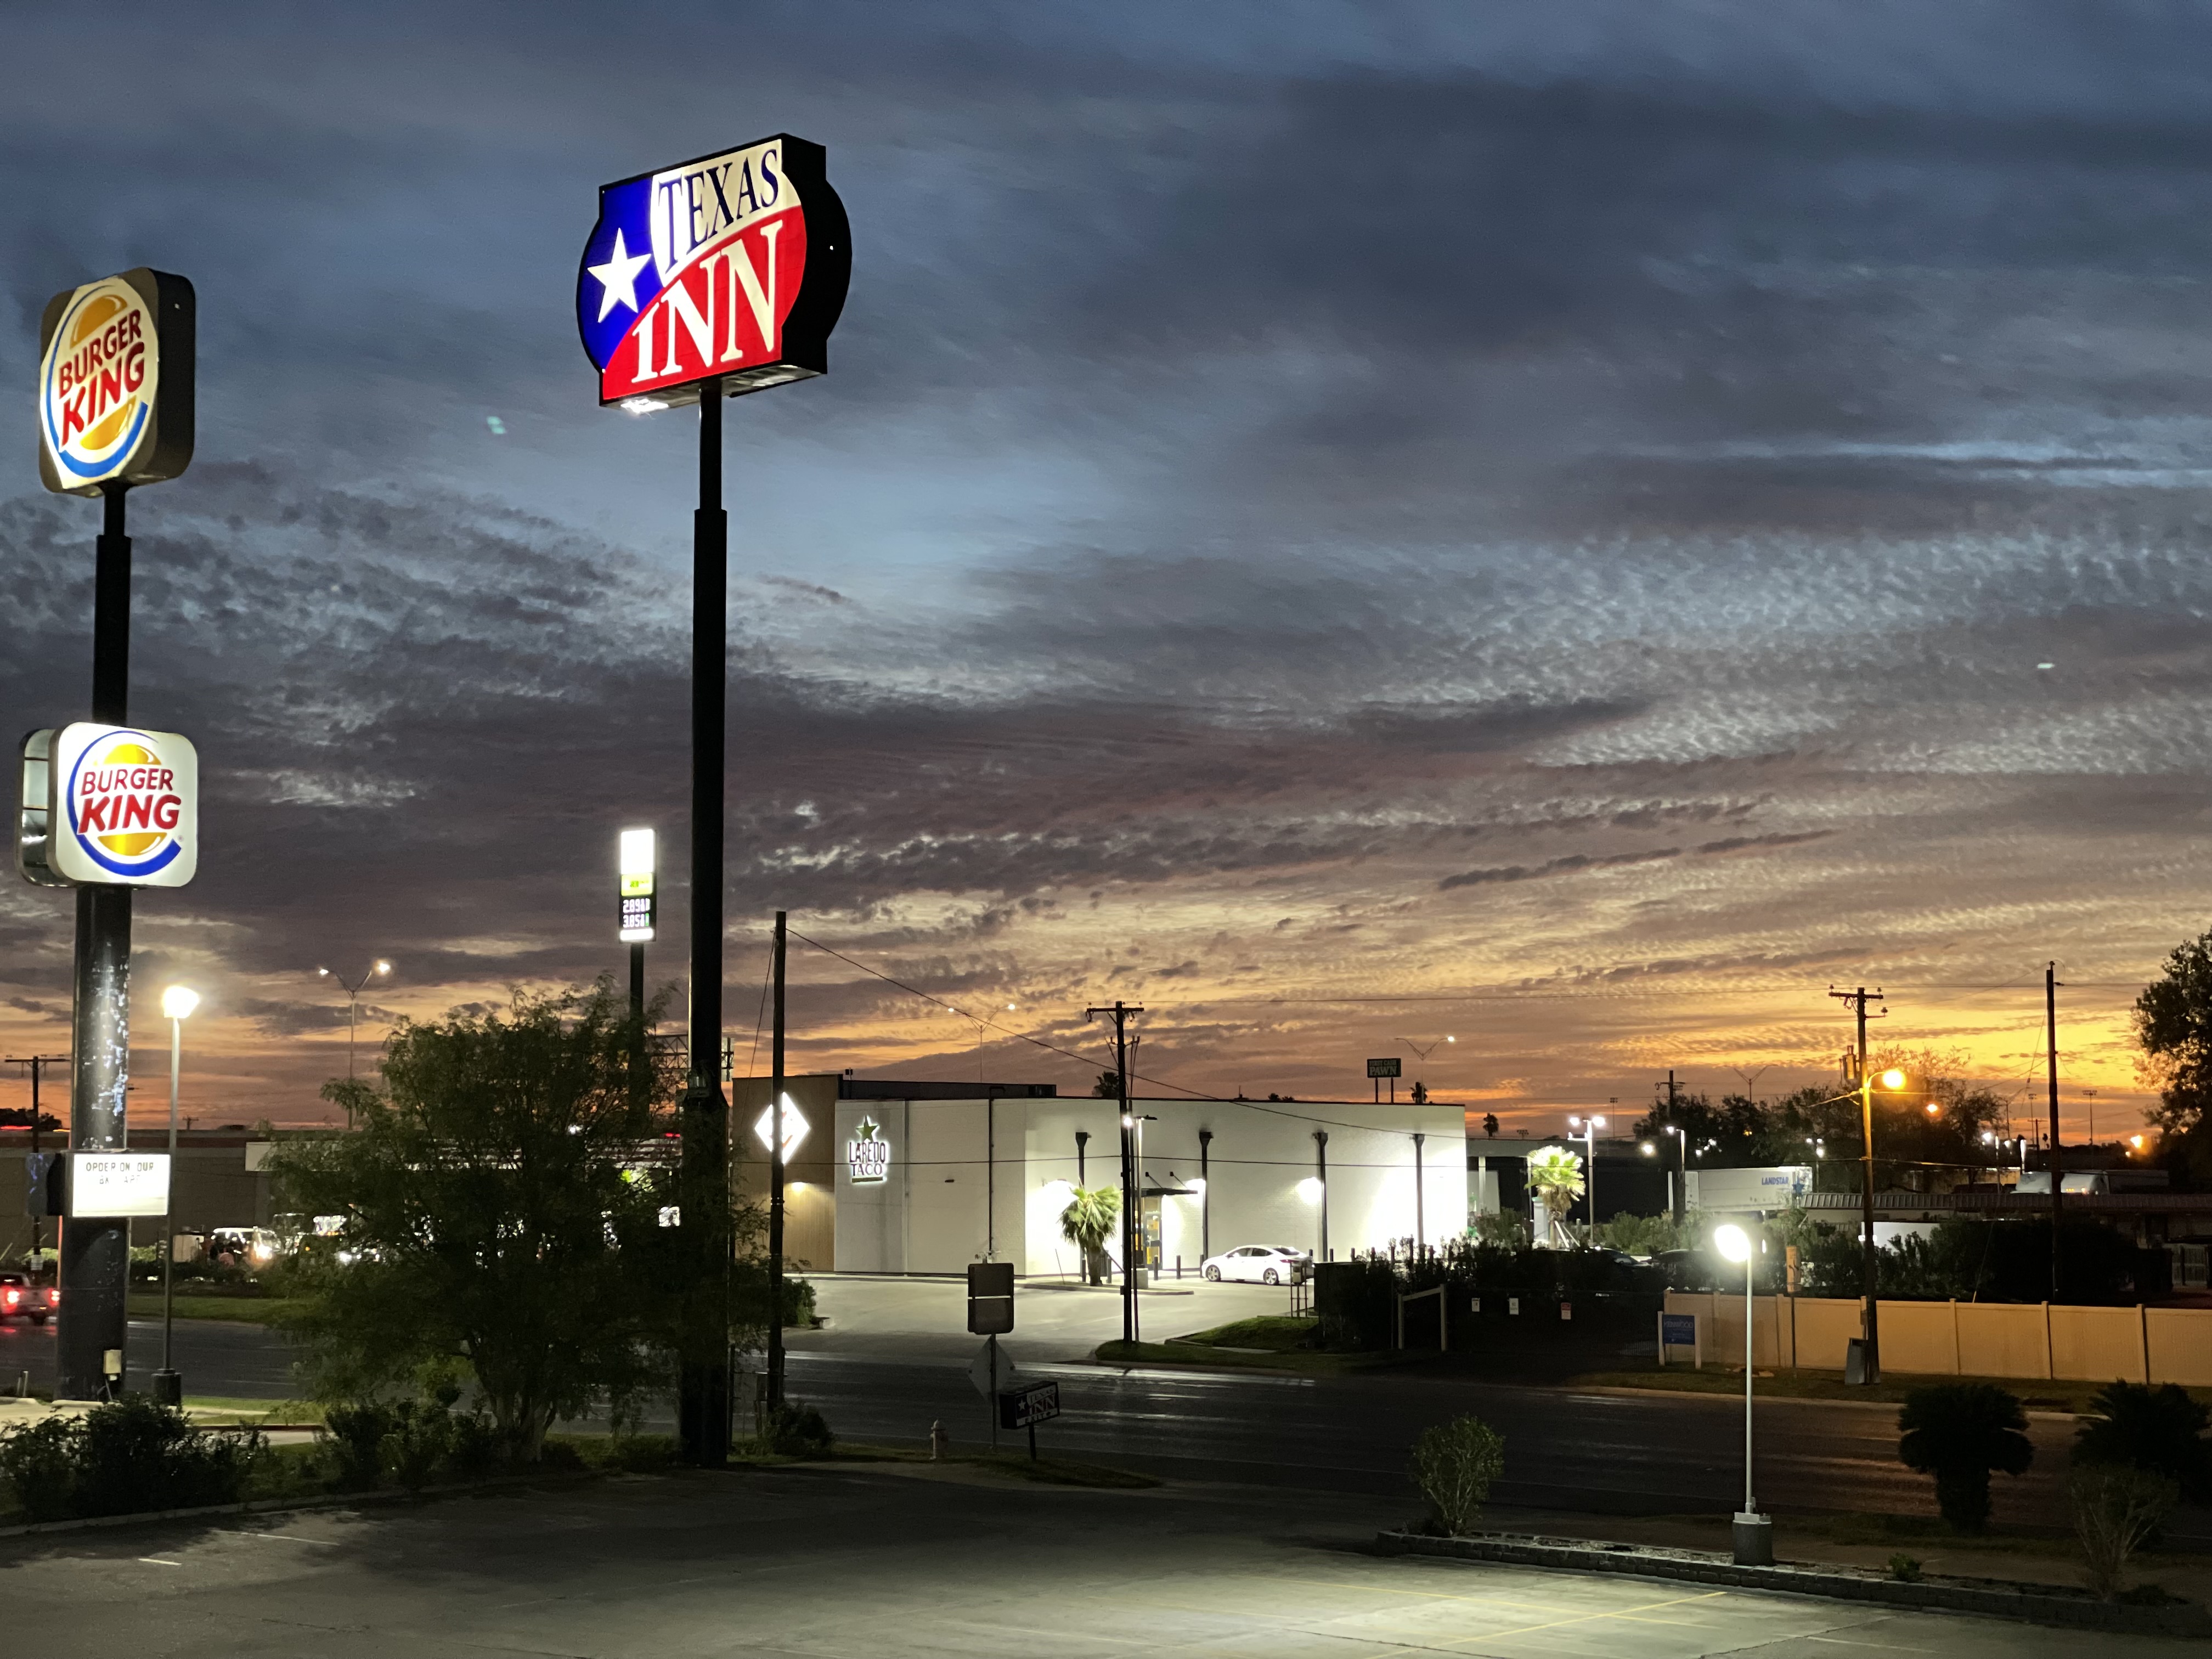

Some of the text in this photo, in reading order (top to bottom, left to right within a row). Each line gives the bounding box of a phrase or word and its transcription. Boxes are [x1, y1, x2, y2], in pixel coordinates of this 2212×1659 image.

[658, 149, 779, 274] TEXAS
[631, 219, 783, 383] INN
[59, 309, 142, 399] BURGER
[62, 342, 145, 447] KING
[80, 768, 173, 796] BURGER
[78, 794, 182, 833] KING
[1369, 1066, 1397, 1076] PAWN
[849, 1142, 885, 1164] LAREDO
[850, 1164, 883, 1176] TACO
[1762, 1177, 1789, 1185] LANDSTAR
[1029, 1393, 1056, 1415] INN
[1025, 1413, 1043, 1424] EXIT
